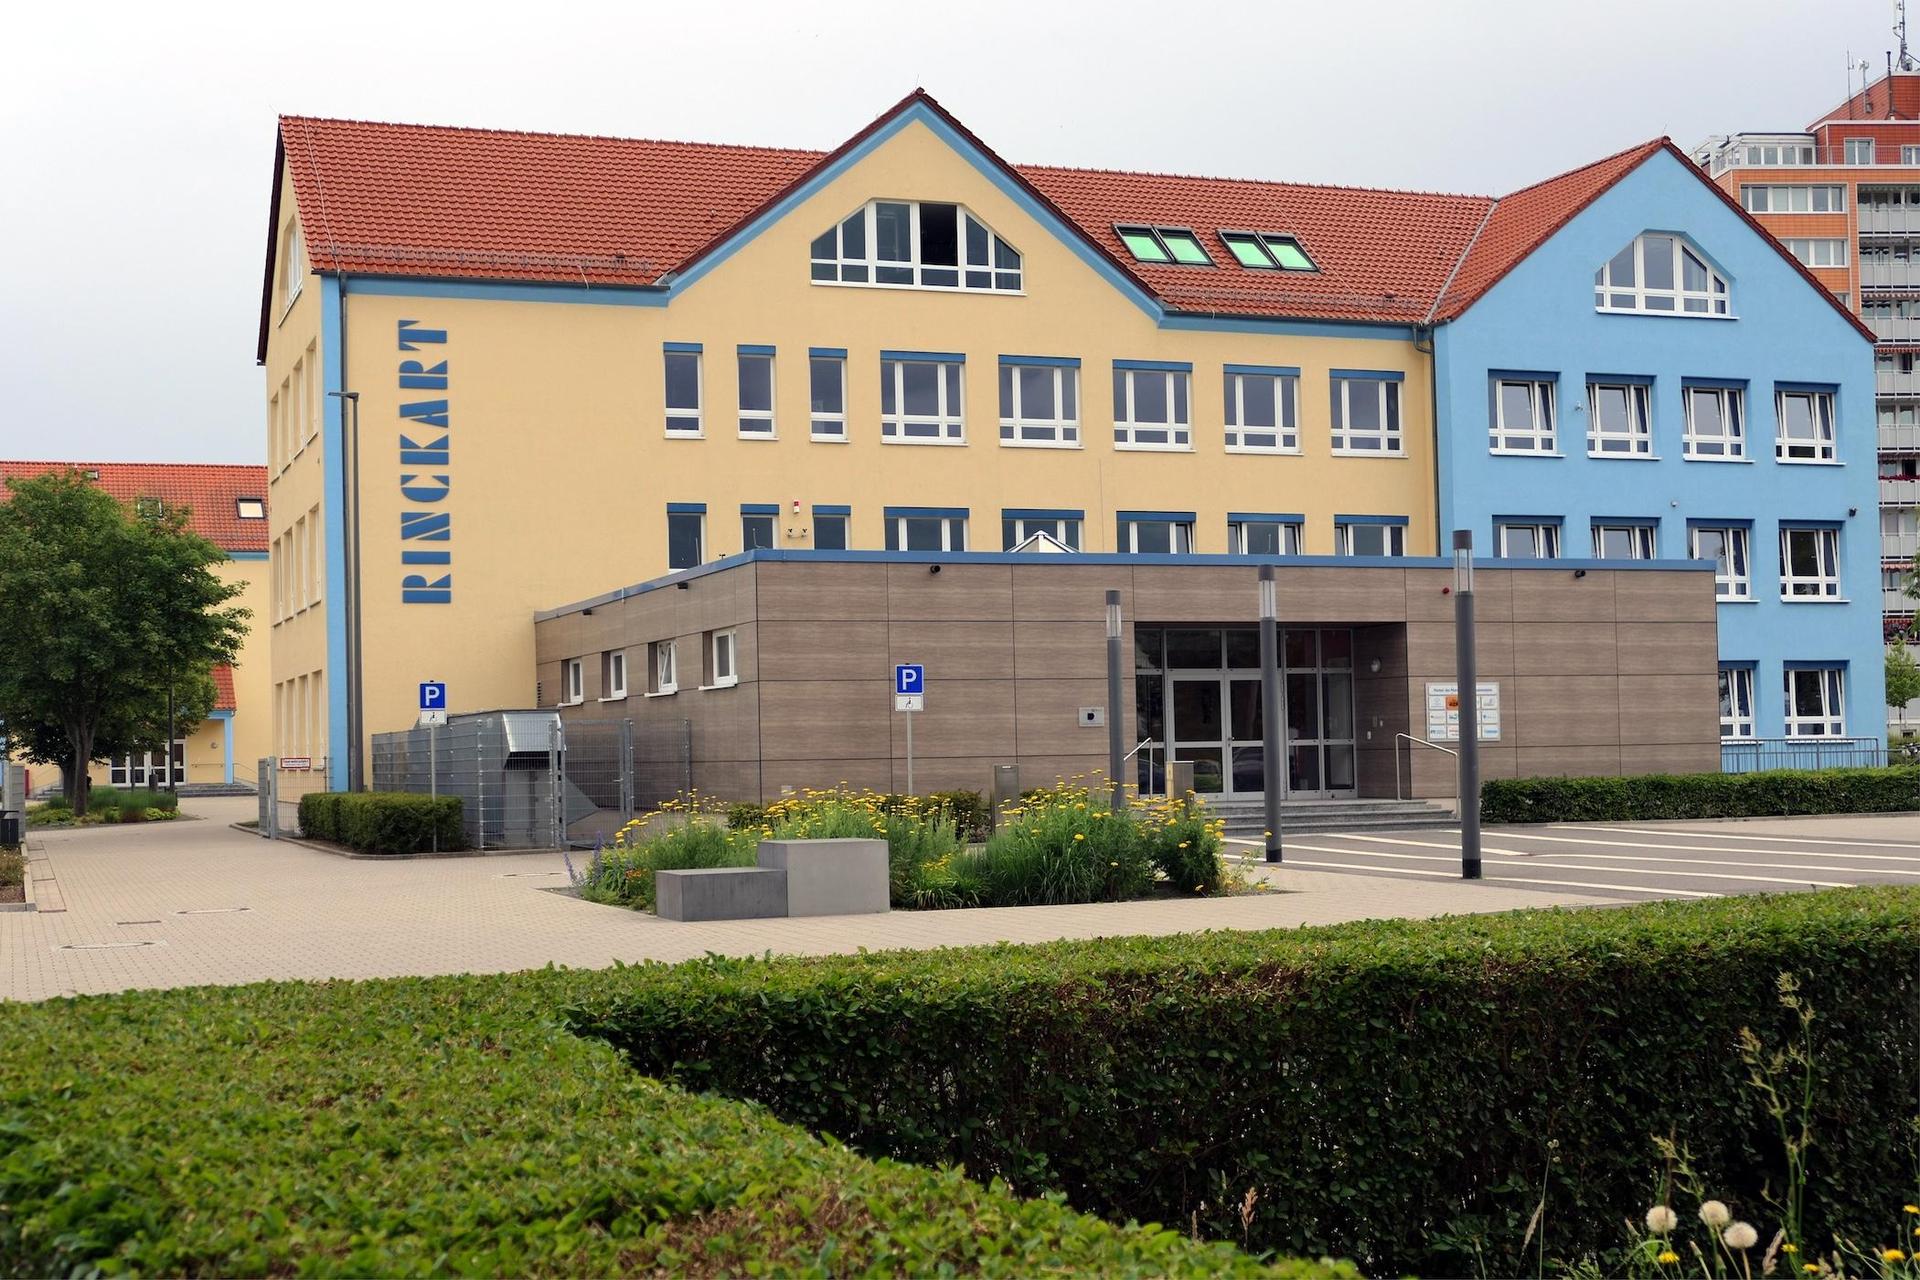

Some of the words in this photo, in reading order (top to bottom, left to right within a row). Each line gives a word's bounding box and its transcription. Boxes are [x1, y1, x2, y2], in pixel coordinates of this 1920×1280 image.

[398, 320, 451, 604] RINCKART
[902, 668, 917, 690] P
[425, 686, 440, 706] P
